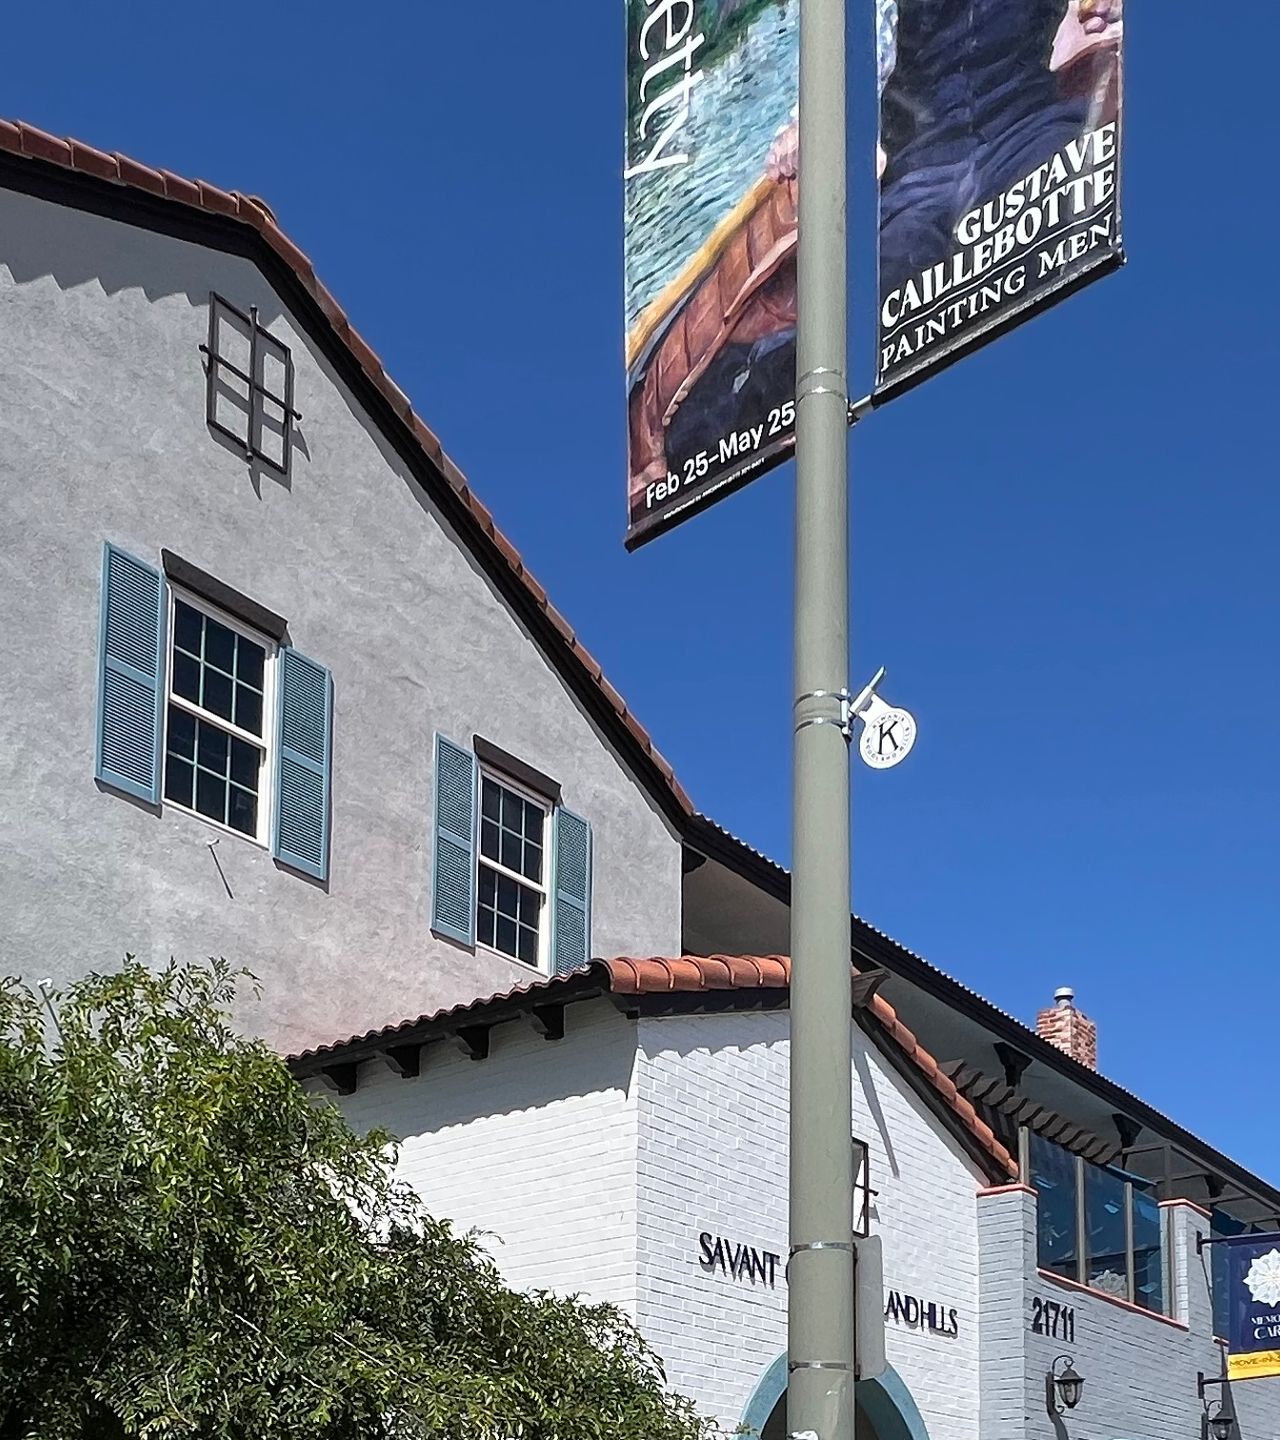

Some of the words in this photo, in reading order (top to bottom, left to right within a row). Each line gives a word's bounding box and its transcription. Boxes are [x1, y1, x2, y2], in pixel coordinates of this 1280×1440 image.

[624, 0, 705, 179] etty
[956, 123, 1116, 247] GUSTAVE
[880, 271, 1026, 371] PAINTING
[1037, 213, 1114, 279] MEN
[881, 168, 1115, 328] CAILLEBOTTE
[645, 471, 680, 509] Feb
[767, 400, 796, 436] 25
[877, 720, 899, 755] K
[698, 1231, 781, 1287] SAVANT
[1032, 1296, 1075, 1342] 21711
